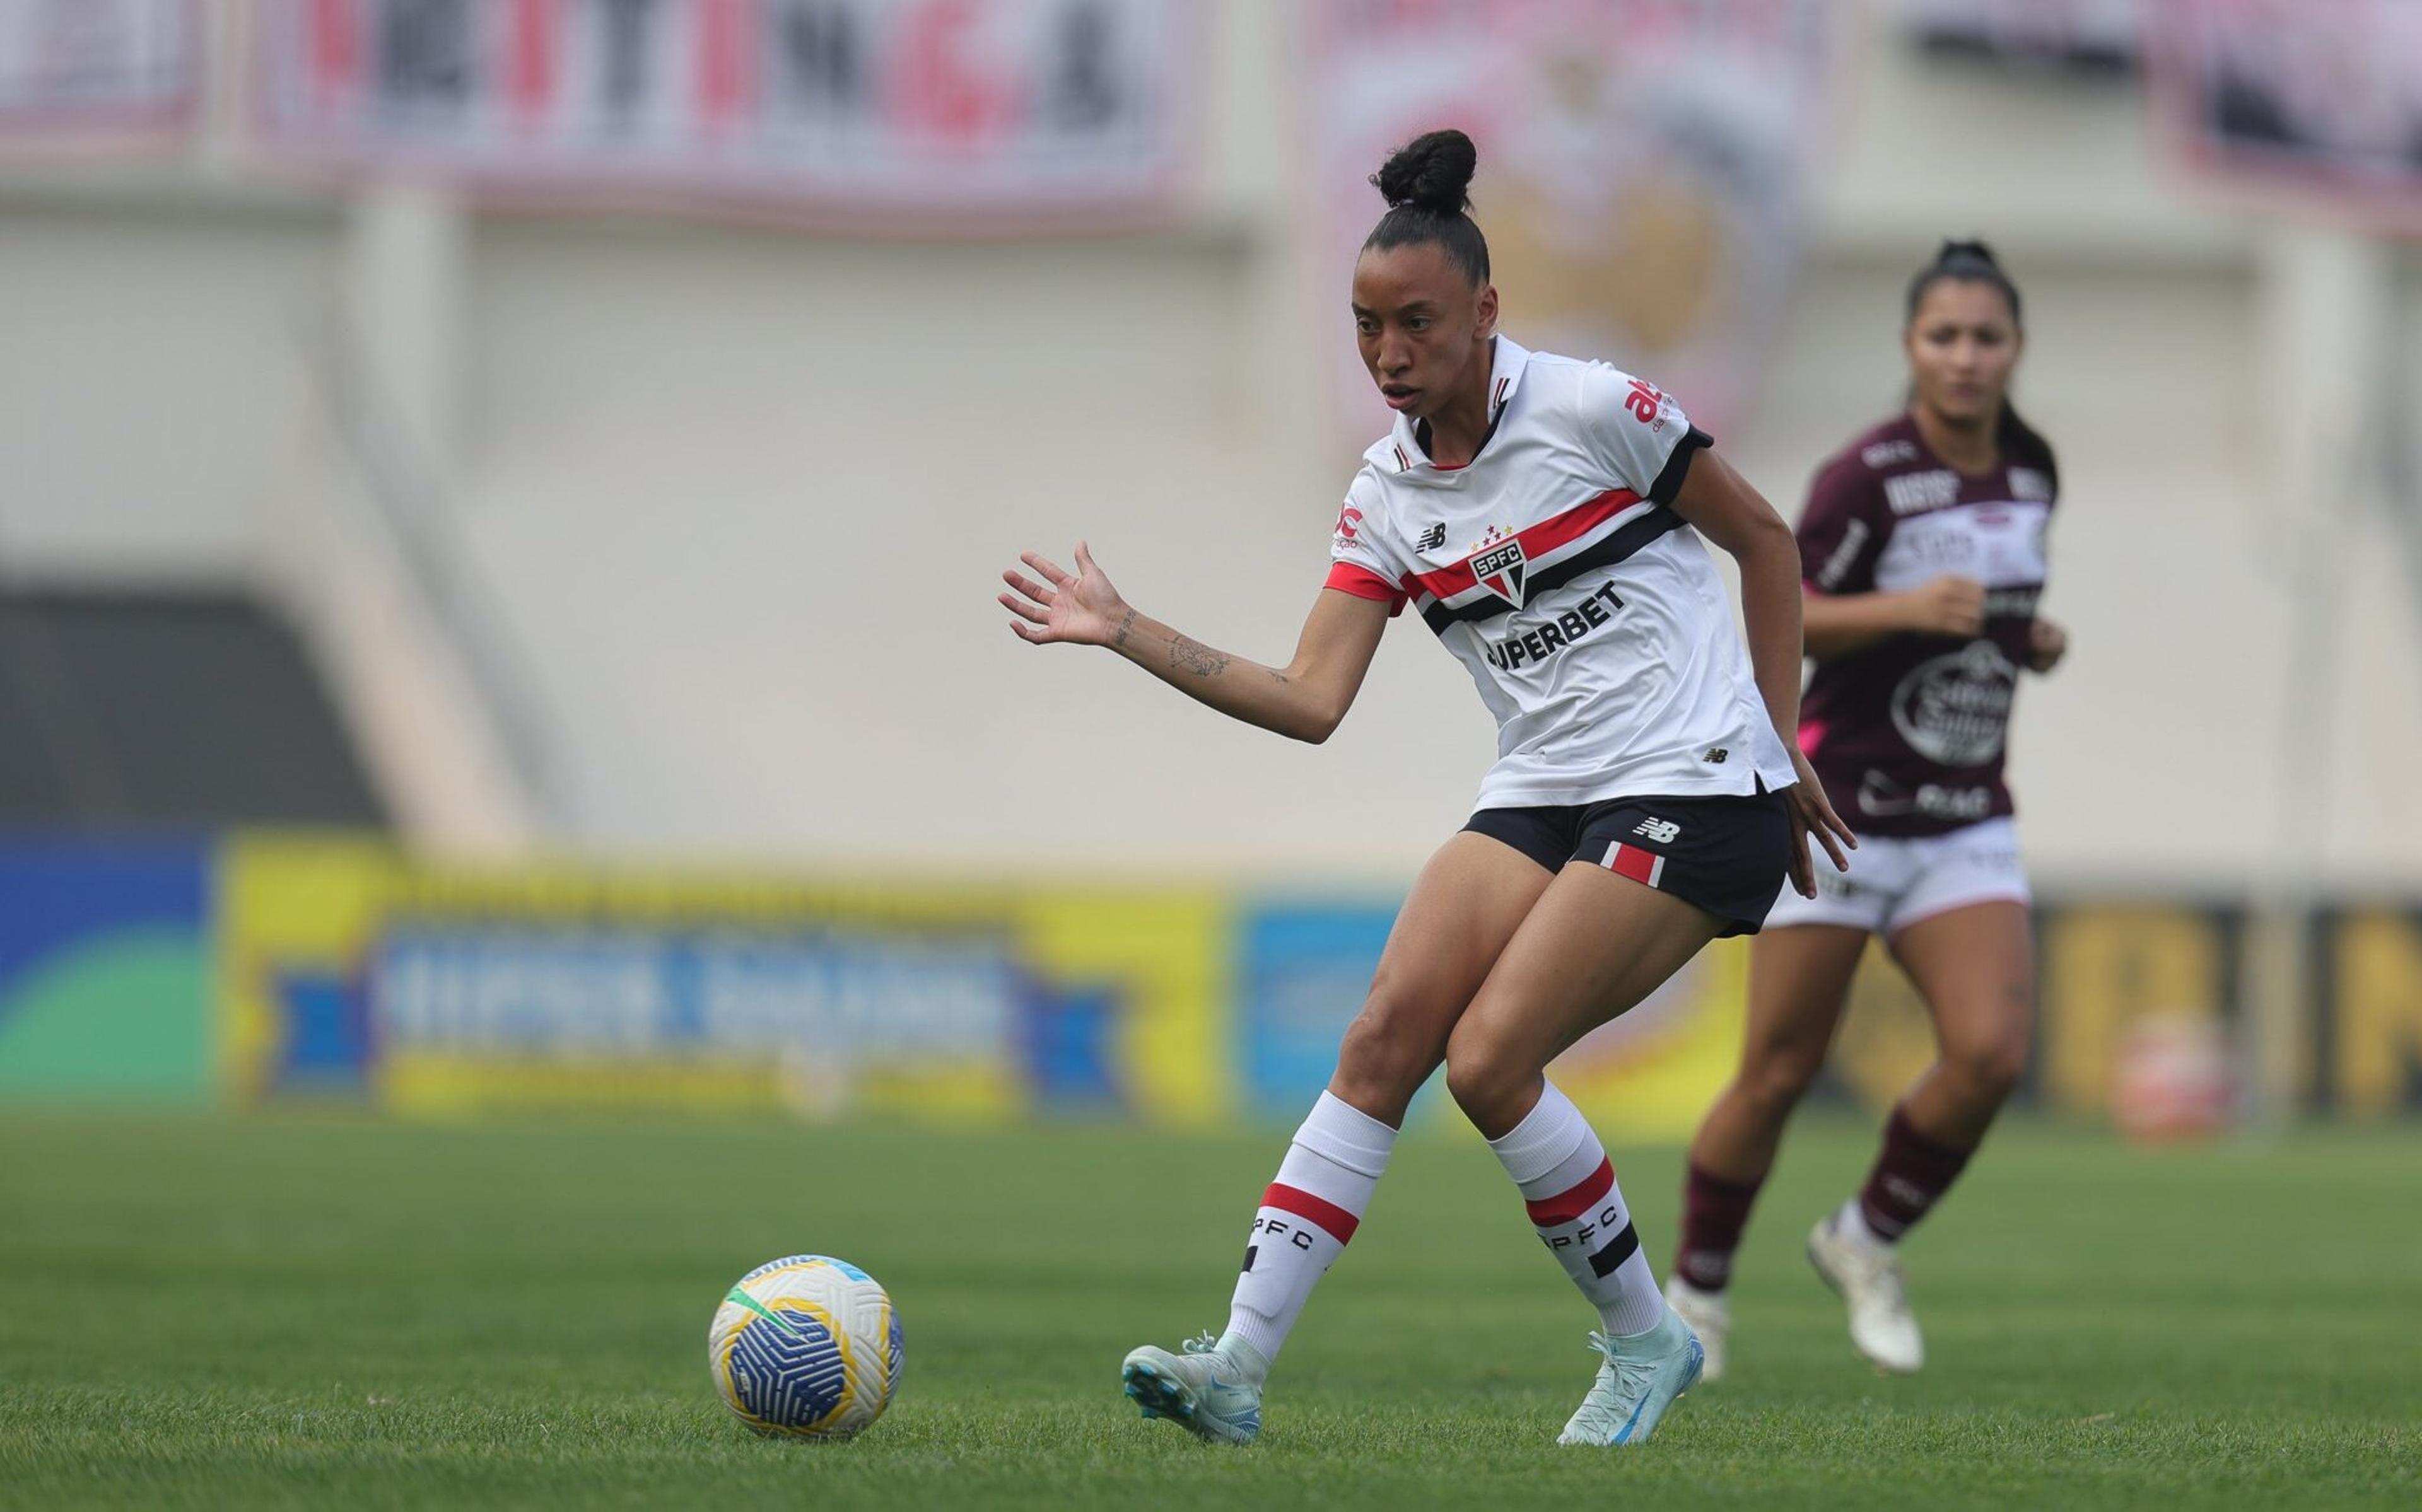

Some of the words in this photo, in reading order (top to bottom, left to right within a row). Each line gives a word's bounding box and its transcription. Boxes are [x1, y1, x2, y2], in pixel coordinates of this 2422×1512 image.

[1335, 504, 1363, 537] c
[1476, 546, 1519, 575] SPFC
[1536, 1205, 1617, 1251] PFC
